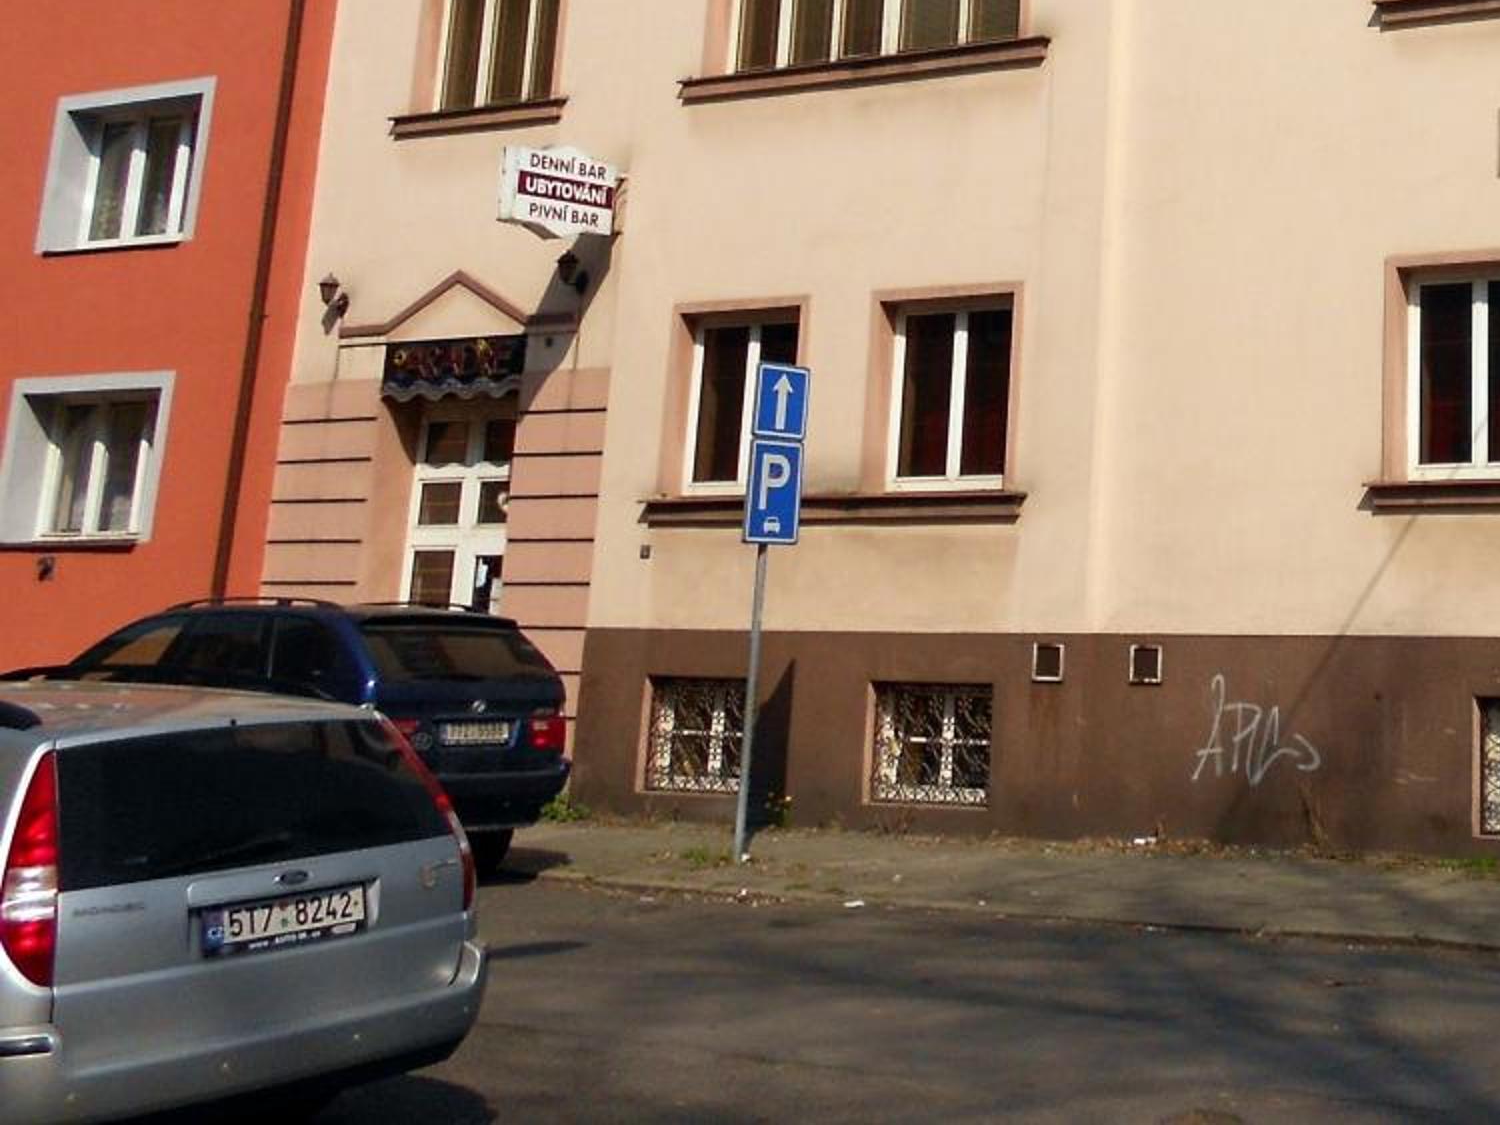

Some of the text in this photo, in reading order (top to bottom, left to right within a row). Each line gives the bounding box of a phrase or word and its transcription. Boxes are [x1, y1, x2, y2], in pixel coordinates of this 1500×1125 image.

[530, 153, 606, 180] DENNÍ BAR
[525, 176, 607, 205] UBYTOVÁNÍ
[529, 203, 599, 227] PIVNÍ BAR
[758, 452, 791, 510] P
[229, 891, 351, 936] 5T7 8242
